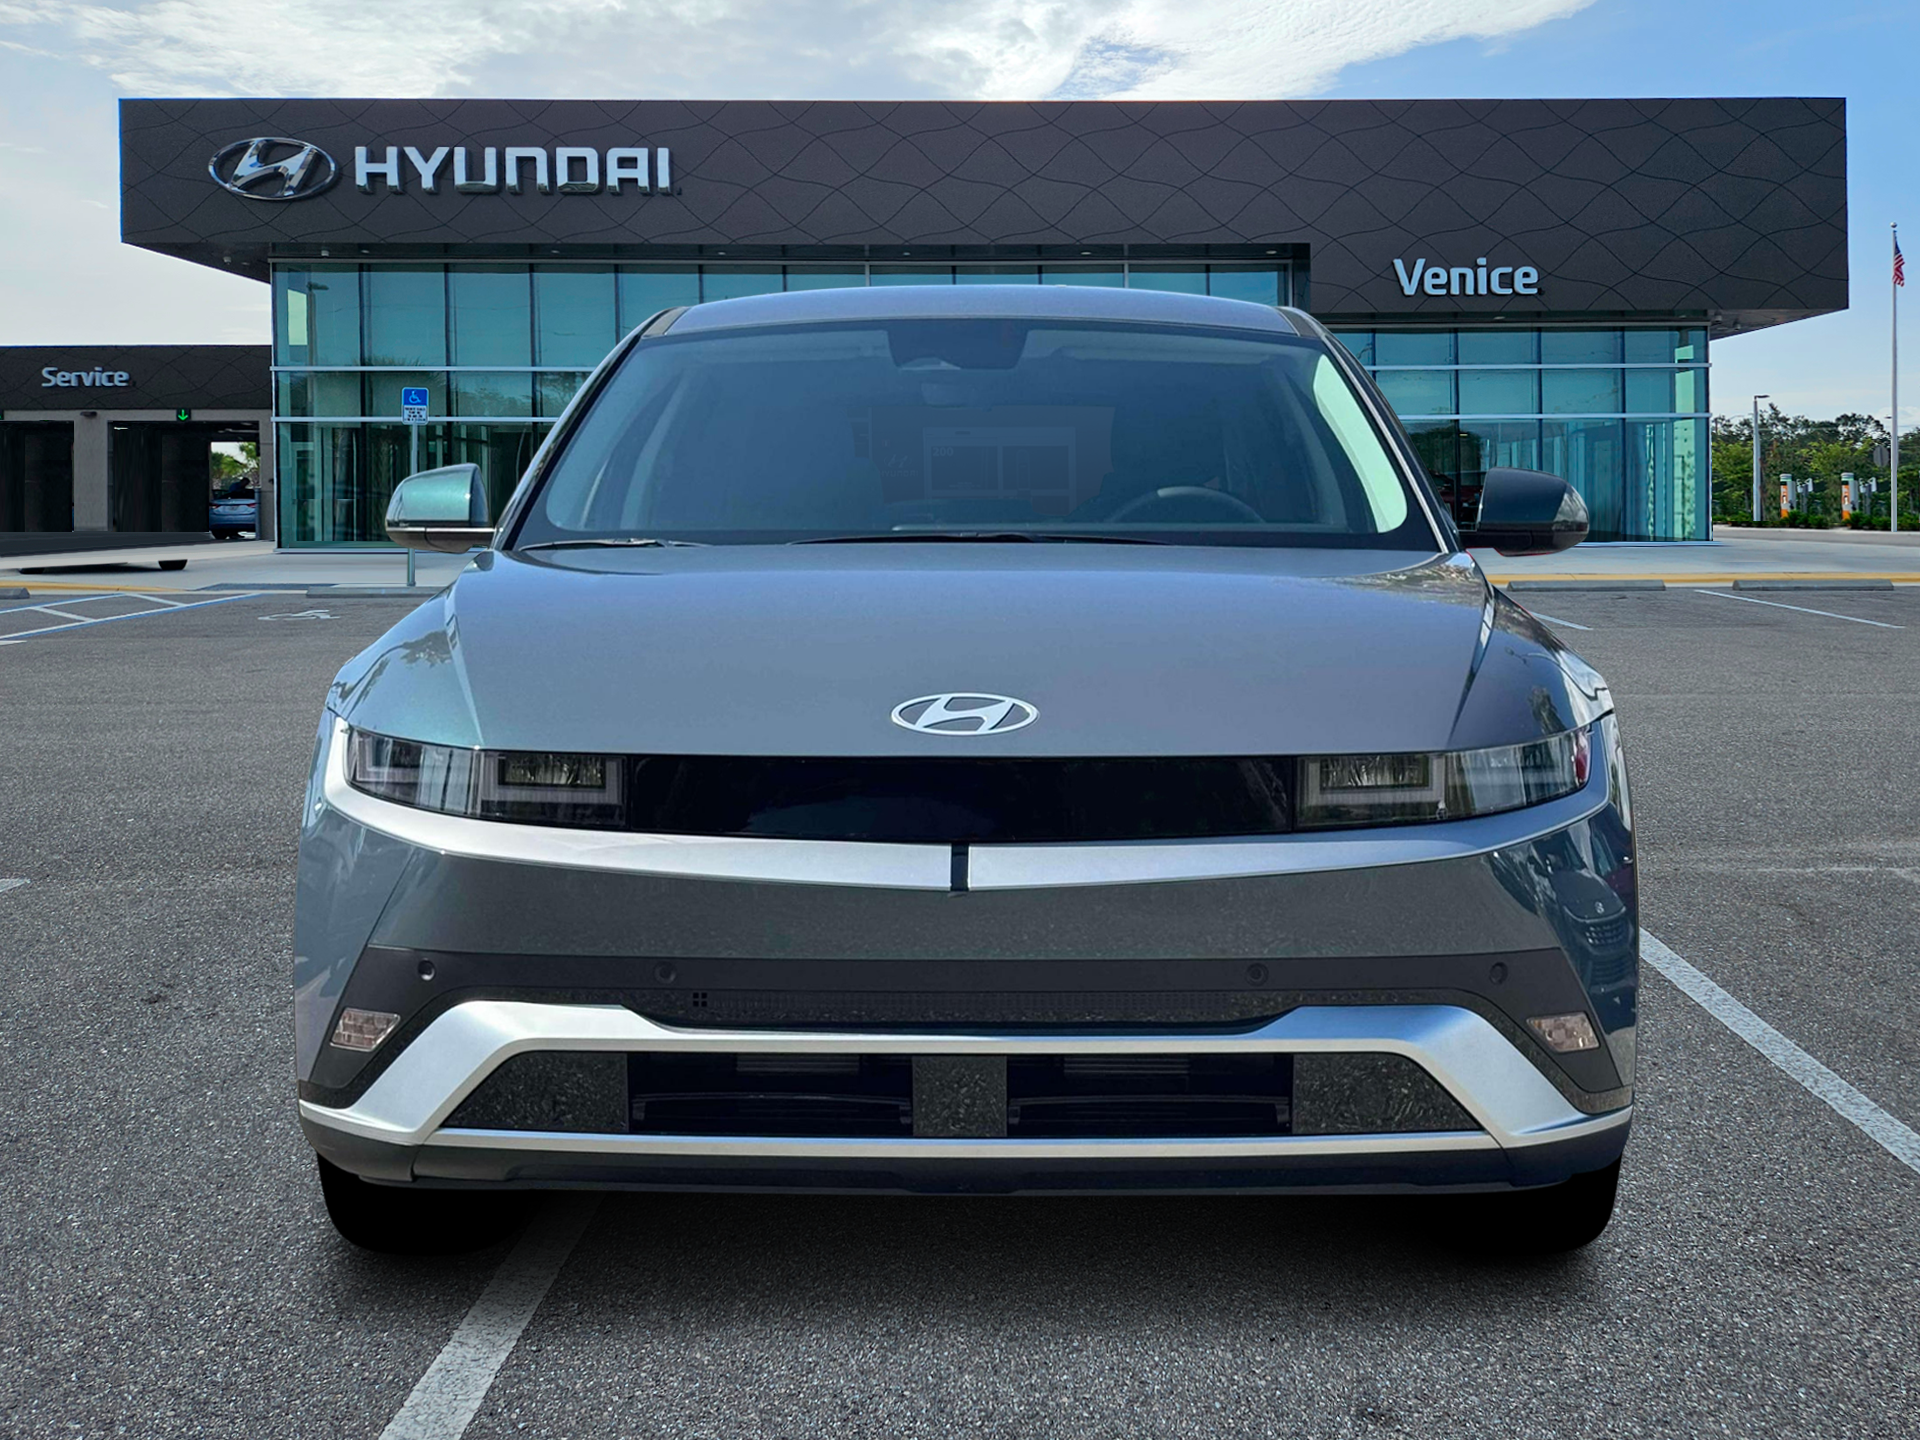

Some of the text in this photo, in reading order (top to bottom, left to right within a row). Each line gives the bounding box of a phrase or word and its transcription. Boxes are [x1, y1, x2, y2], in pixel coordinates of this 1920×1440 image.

[354, 146, 674, 195] HYUNDAI
[1392, 257, 1539, 295] Venice
[41, 366, 130, 387] Service
[932, 446, 954, 457] 200
